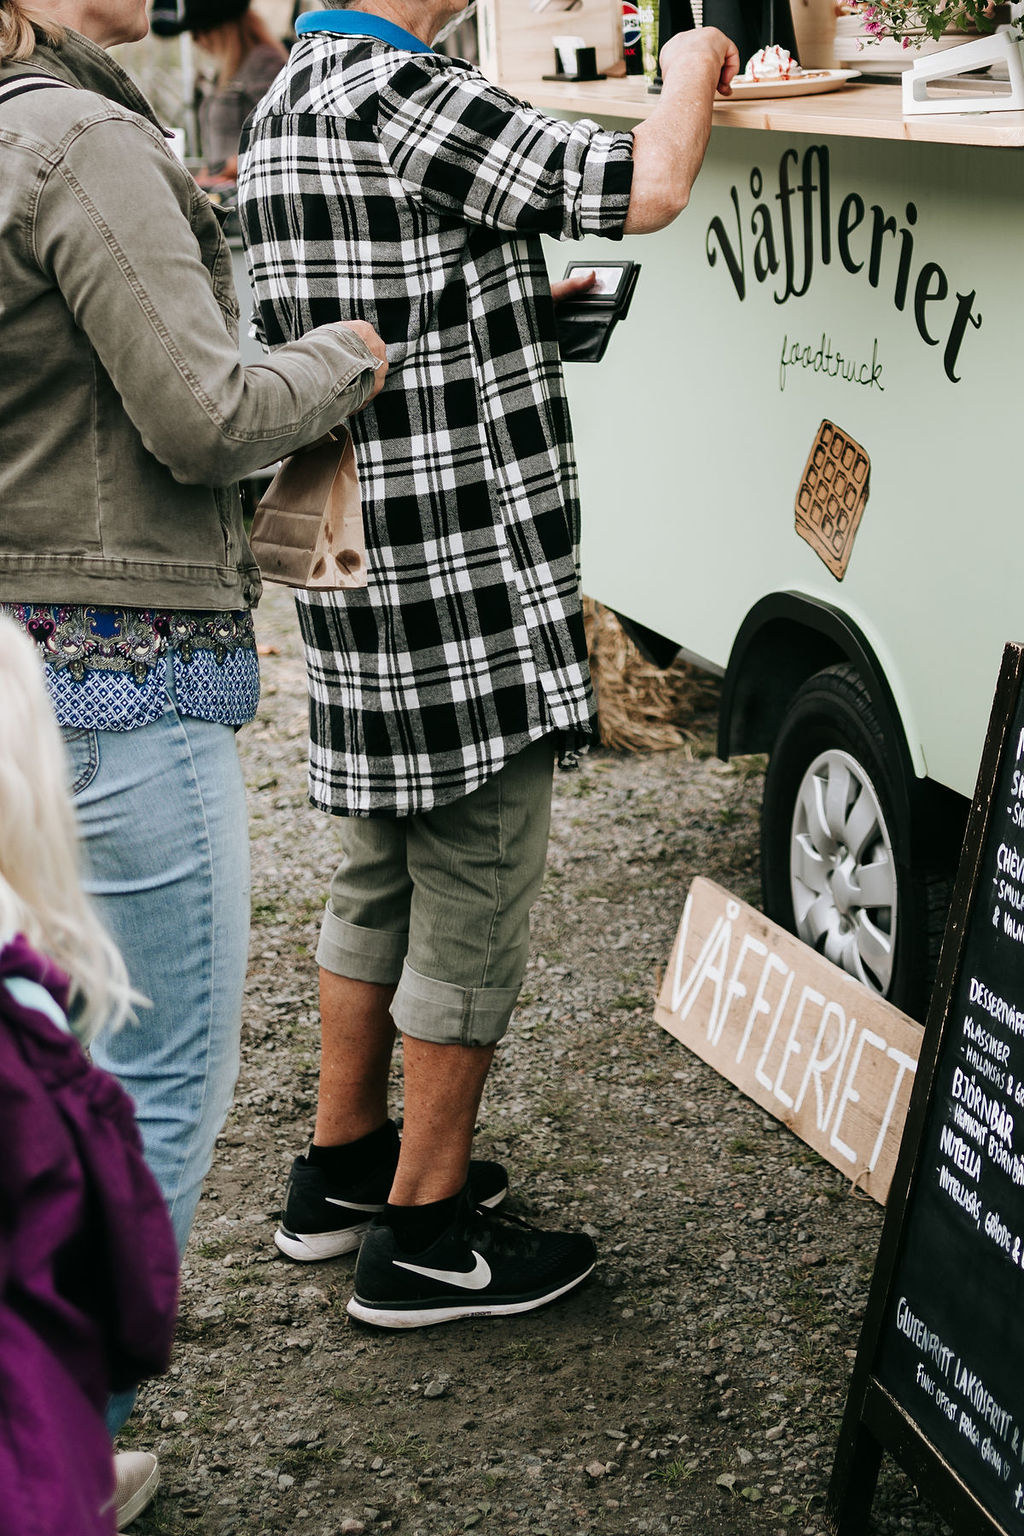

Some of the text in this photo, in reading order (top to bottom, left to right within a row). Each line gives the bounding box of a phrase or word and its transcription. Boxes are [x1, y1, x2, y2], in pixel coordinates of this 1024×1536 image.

[778, 332, 885, 392] foodtruck
[992, 905, 1001, 929] &
[671, 893, 918, 1173] VÅFFLERIET
[963, 1015, 1011, 1068] KLASSIKER
[1006, 1074, 1014, 1096] &
[939, 1124, 981, 1183] NUTELLA
[1011, 1236, 1021, 1265] &
[1011, 1426, 1020, 1456] &
